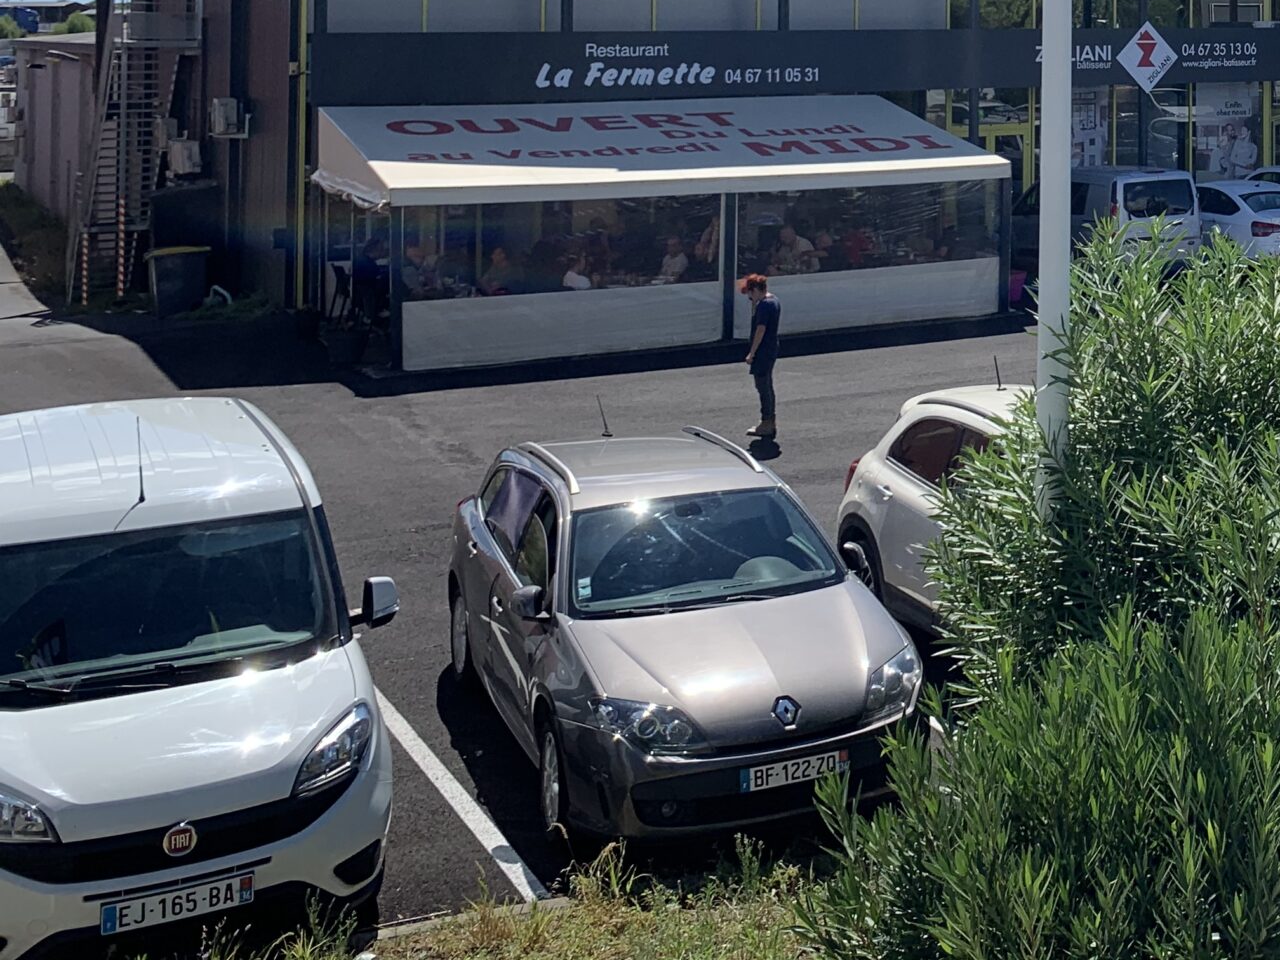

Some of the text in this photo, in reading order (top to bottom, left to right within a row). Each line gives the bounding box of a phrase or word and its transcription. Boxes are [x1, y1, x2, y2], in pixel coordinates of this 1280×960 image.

[585, 43, 669, 57] Restaurant
[1182, 43, 1257, 56] 04 67 35 13 06
[535, 62, 820, 88] La Fermette 04 67 11 05 31
[1077, 61, 1112, 70] bâtisseur
[1147, 55, 1172, 84] ZIGLIANI
[386, 111, 736, 136] OUVERT
[660, 124, 865, 139] Du Lundi
[407, 142, 721, 161] au Vendredi
[742, 135, 953, 157] MIDI
[171, 833, 191, 850] FIAT
[119, 883, 234, 928] EJ-165-BA
